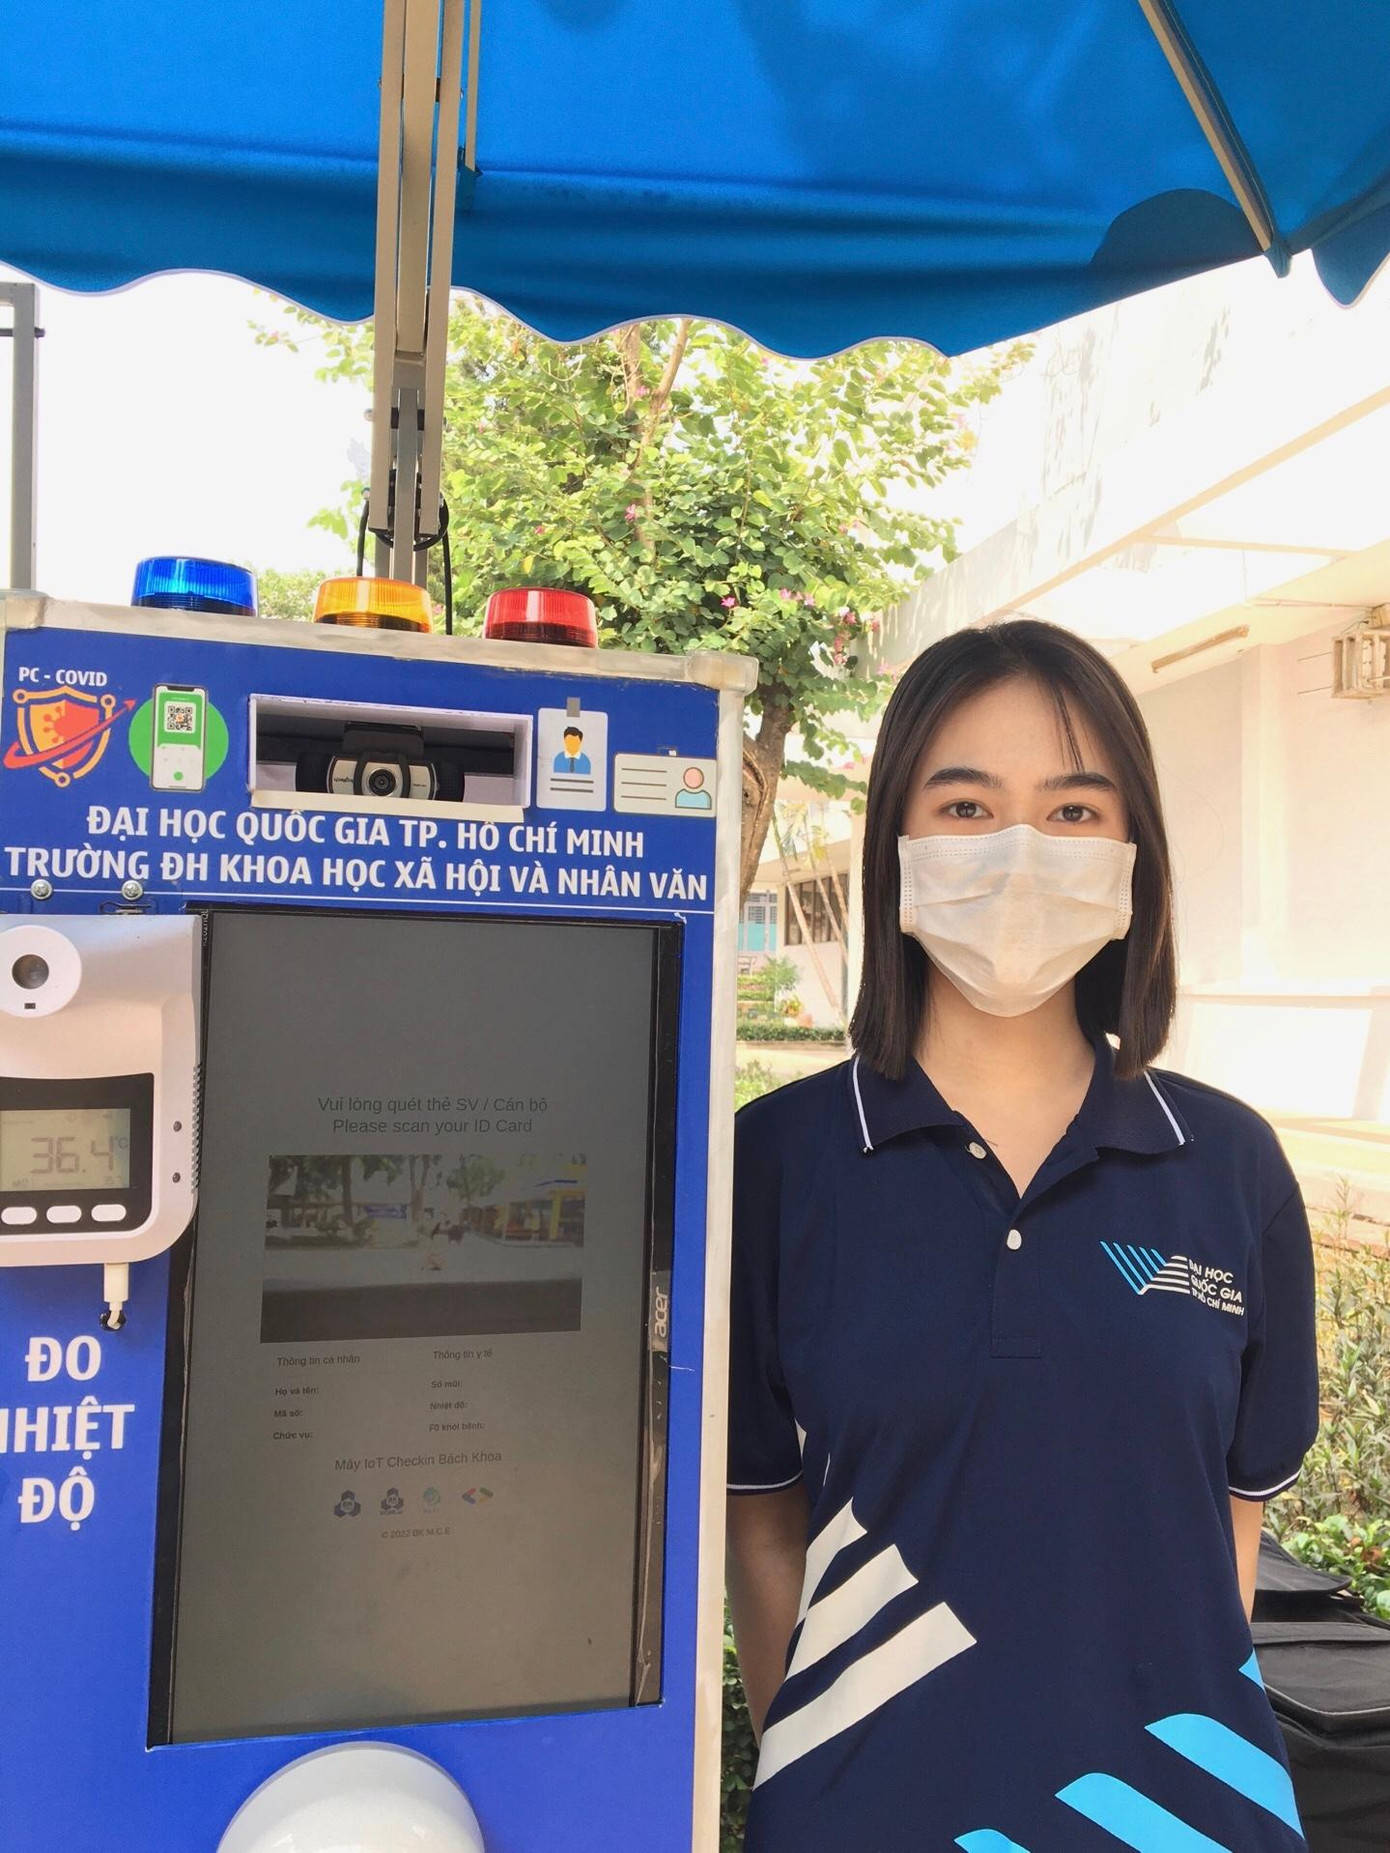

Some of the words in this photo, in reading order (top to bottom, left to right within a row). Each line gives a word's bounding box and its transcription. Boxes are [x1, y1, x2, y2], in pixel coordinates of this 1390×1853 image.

[19, 667, 39, 683] PC
[55, 670, 107, 687] COVID
[87, 805, 148, 841] ĐẠI
[160, 808, 226, 844] HỌC
[335, 816, 390, 846] GIA
[399, 819, 447, 849] TP.
[508, 821, 558, 854] CHÍ
[567, 828, 644, 859] MINH
[5, 842, 149, 881] TRƯỜNG
[160, 851, 208, 881] ĐH
[220, 854, 312, 885] KHOA
[322, 857, 386, 893] HỌC
[394, 856, 437, 890] XÃ
[445, 858, 501, 897] HỘI
[509, 860, 549, 894] VÀ
[558, 865, 640, 898] NHÂN
[649, 868, 707, 901] VĂN
[318, 1097, 342, 1112] Vui
[387, 1097, 421, 1115] quét
[456, 1097, 479, 1112] SV
[494, 1097, 523, 1112] Cán
[333, 1118, 387, 1133] Please
[393, 1122, 430, 1133] scan
[435, 1122, 468, 1136] your
[474, 1118, 490, 1132] ID
[496, 1118, 532, 1133] Card
[31, 1136, 114, 1175] 36.4
[1204, 1266, 1234, 1284] HỌC
[1220, 1287, 1243, 1303] GIA
[654, 1286, 668, 1338] acer
[1221, 1302, 1245, 1316] MINH
[25, 1335, 101, 1382] ĐO
[335, 1458, 361, 1472] Máy
[364, 1456, 385, 1469] IoT
[387, 1454, 436, 1468] Checkin
[438, 1452, 468, 1465] Bách
[472, 1450, 502, 1463] Khoa
[18, 1466, 95, 1531] ĐỘ
